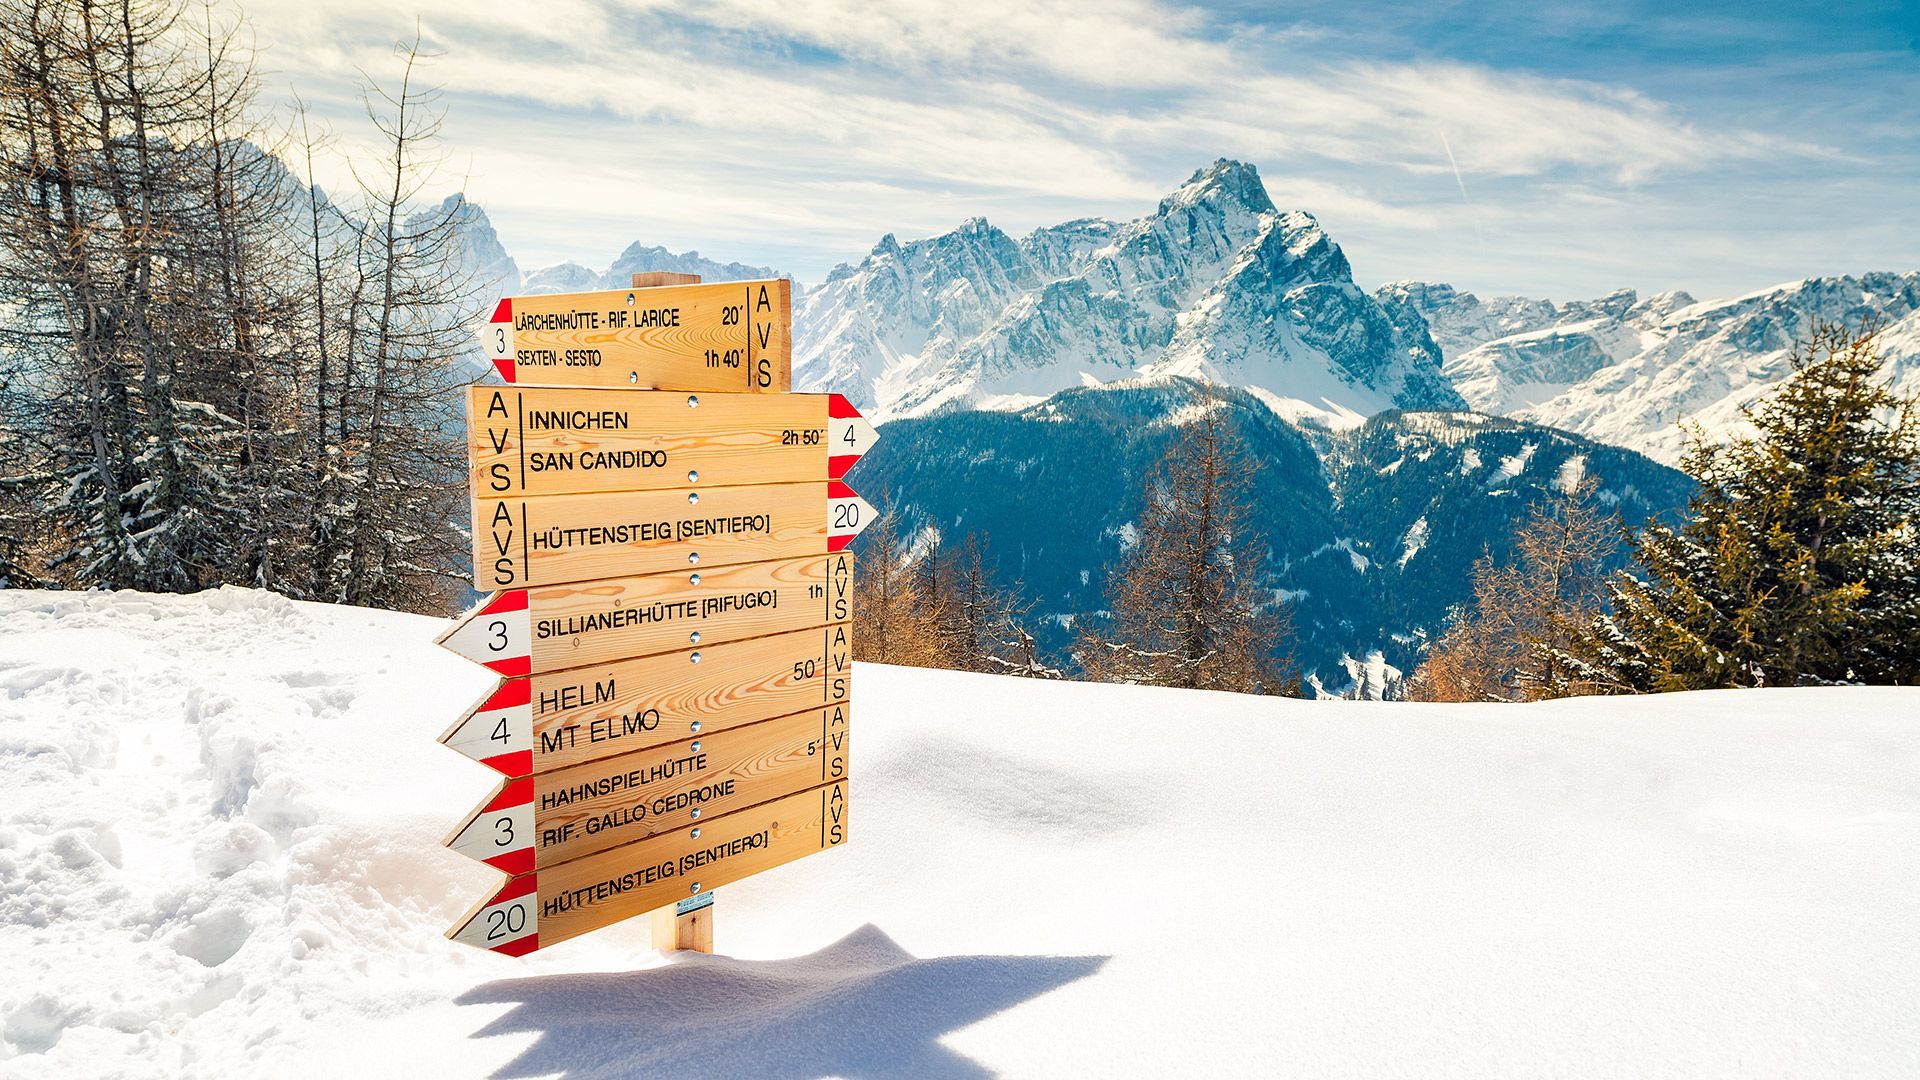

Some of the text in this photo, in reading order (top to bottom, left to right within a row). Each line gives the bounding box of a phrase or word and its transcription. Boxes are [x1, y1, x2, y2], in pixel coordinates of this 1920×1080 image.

[515, 309, 599, 332] LÄRCHENHÜTTE
[608, 310, 631, 329] RIF.
[633, 308, 680, 328] LARICE
[495, 328, 506, 354] 3
[517, 349, 557, 366] SEXTEN
[565, 349, 602, 367] SESTO
[704, 349, 720, 368] 1h
[529, 410, 628, 430] INNICHEN
[782, 429, 799, 445] 2h
[843, 424, 856, 447] 4
[530, 450, 667, 472] SAN CANDIDO
[834, 503, 859, 529] 20
[533, 514, 770, 550] HÜTTENSTEIG [SENTIERO]
[808, 584, 823, 599] 1h
[537, 589, 777, 640] SILLIANERHÜTTE [RIFUGIO]
[488, 620, 508, 652] 3
[540, 679, 616, 715] HELM
[490, 717, 512, 745] 4
[541, 708, 660, 755] MT ELMO
[541, 753, 707, 811] HAHNSPIELHÜTTE
[542, 780, 735, 849] RIF. GALLO CEDRONE
[494, 816, 514, 847] 3
[543, 861, 675, 917] HÜTTENSTEIG
[679, 831, 768, 875] [SENTIERO]
[486, 904, 526, 941] 20
